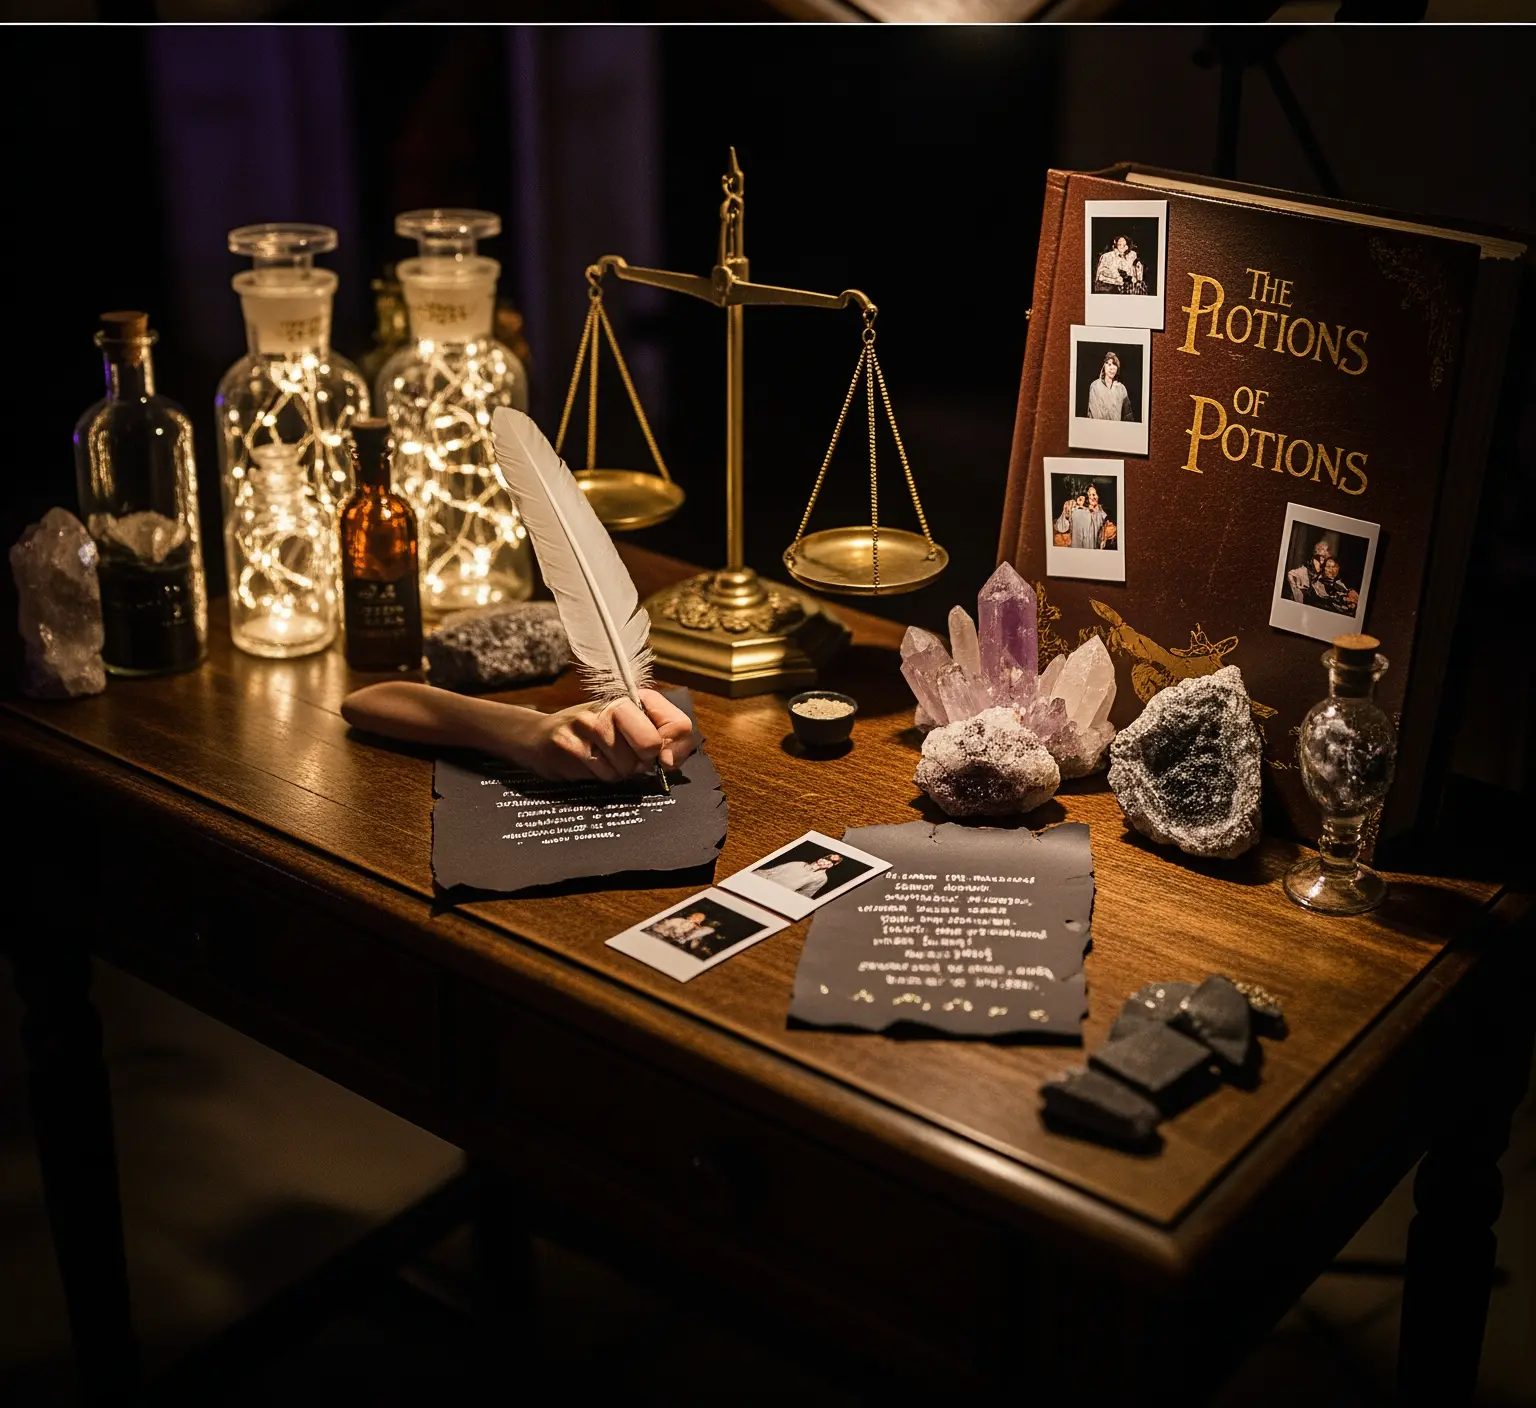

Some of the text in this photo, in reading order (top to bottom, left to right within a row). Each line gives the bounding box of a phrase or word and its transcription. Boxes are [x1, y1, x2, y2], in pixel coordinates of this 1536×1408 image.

[1246, 267, 1294, 308] THE
[1233, 385, 1269, 418] OF
[1180, 394, 1369, 496] POTIONS
